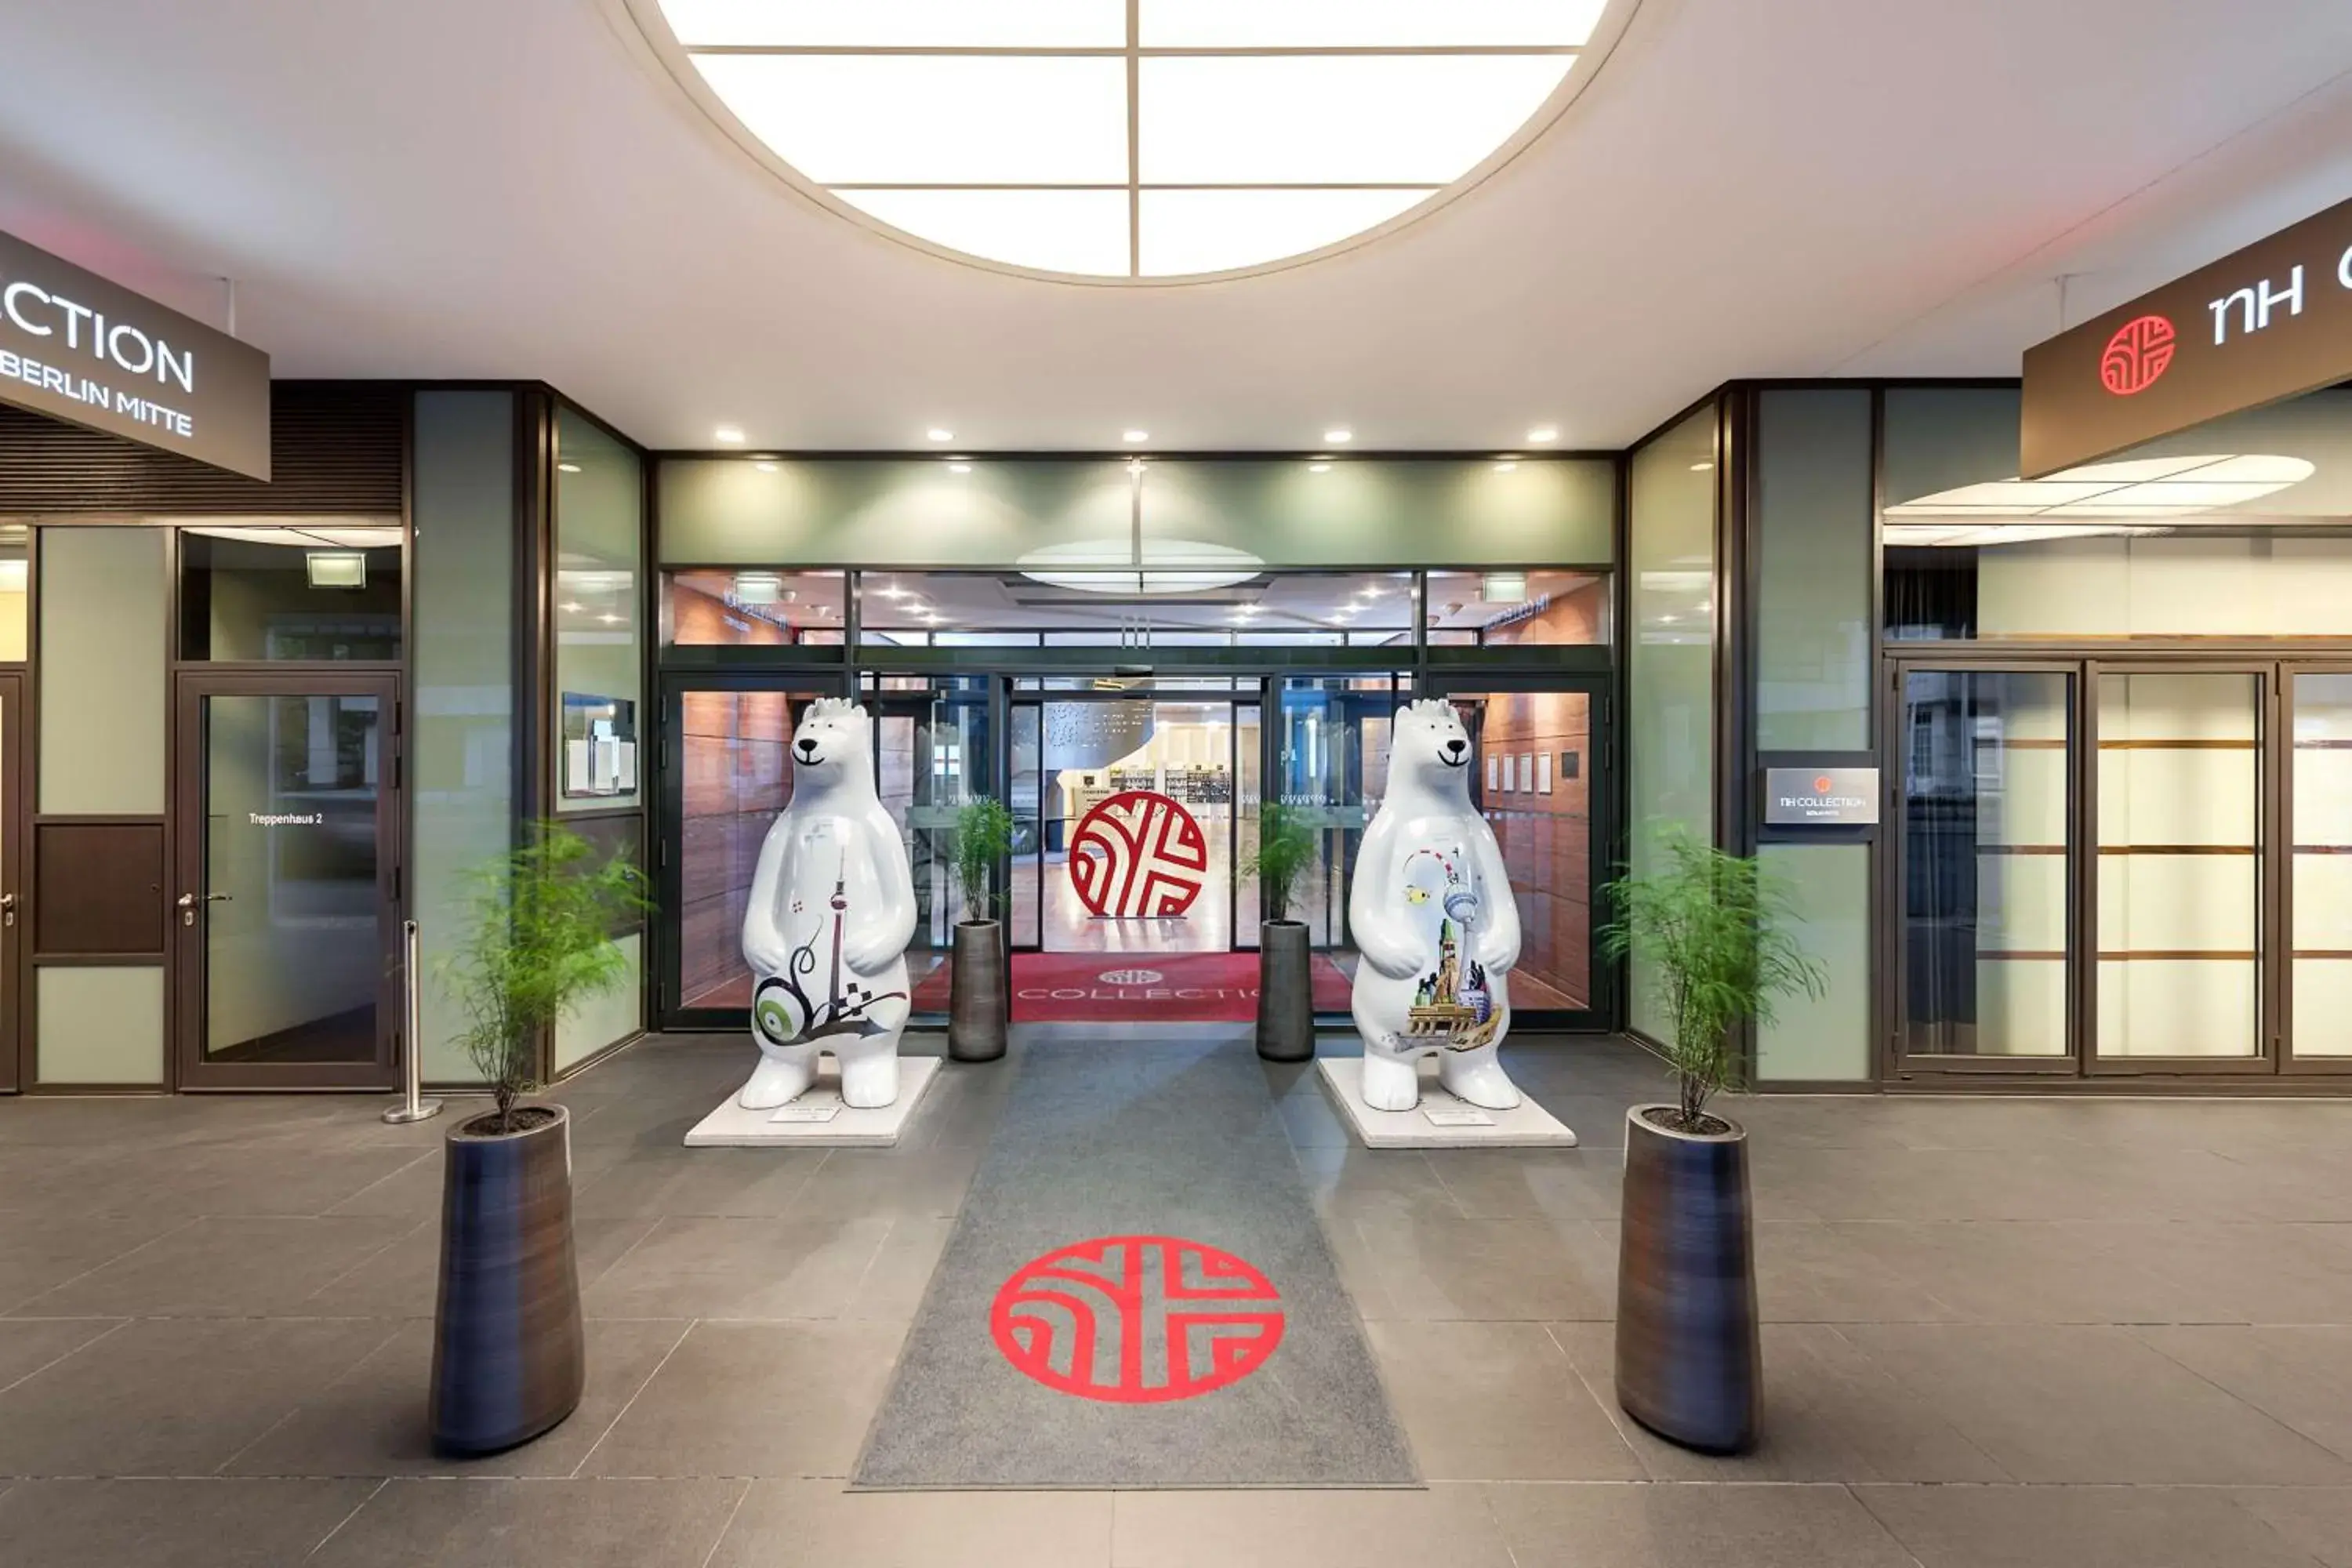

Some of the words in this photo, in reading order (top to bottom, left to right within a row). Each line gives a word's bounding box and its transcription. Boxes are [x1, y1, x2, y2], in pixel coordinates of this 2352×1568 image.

[0, 282, 193, 394] CTION
[0, 350, 109, 408] BERLIN
[117, 391, 193, 437] MITTE
[249, 812, 314, 826] Treppenhaus
[316, 813, 322, 824] 2
[1797, 797, 1867, 807] COLLECTION
